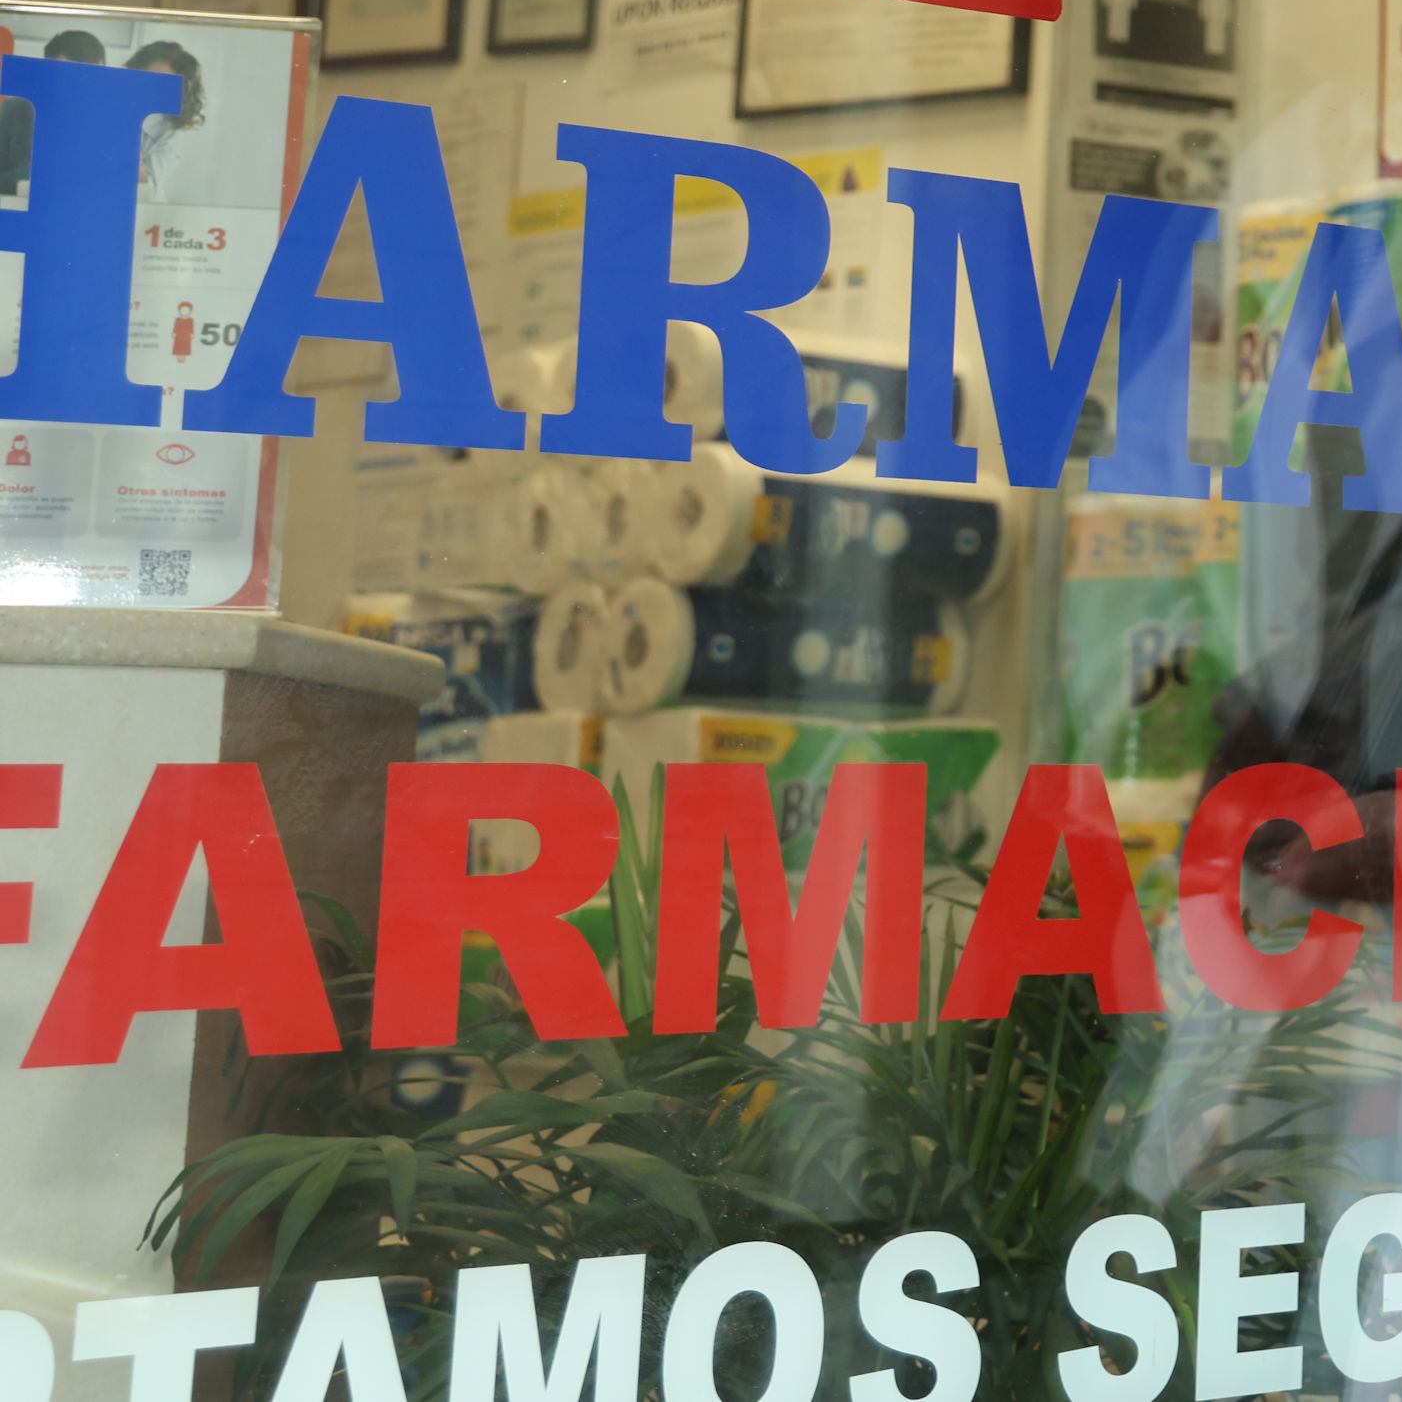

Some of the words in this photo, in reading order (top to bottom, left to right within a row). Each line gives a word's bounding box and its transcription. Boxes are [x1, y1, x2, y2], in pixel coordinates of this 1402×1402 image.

[144, 225, 160, 249] 1
[163, 226, 184, 239] de
[206, 227, 227, 251] 3
[162, 238, 204, 250] cada
[117, 485, 157, 497] Otros
